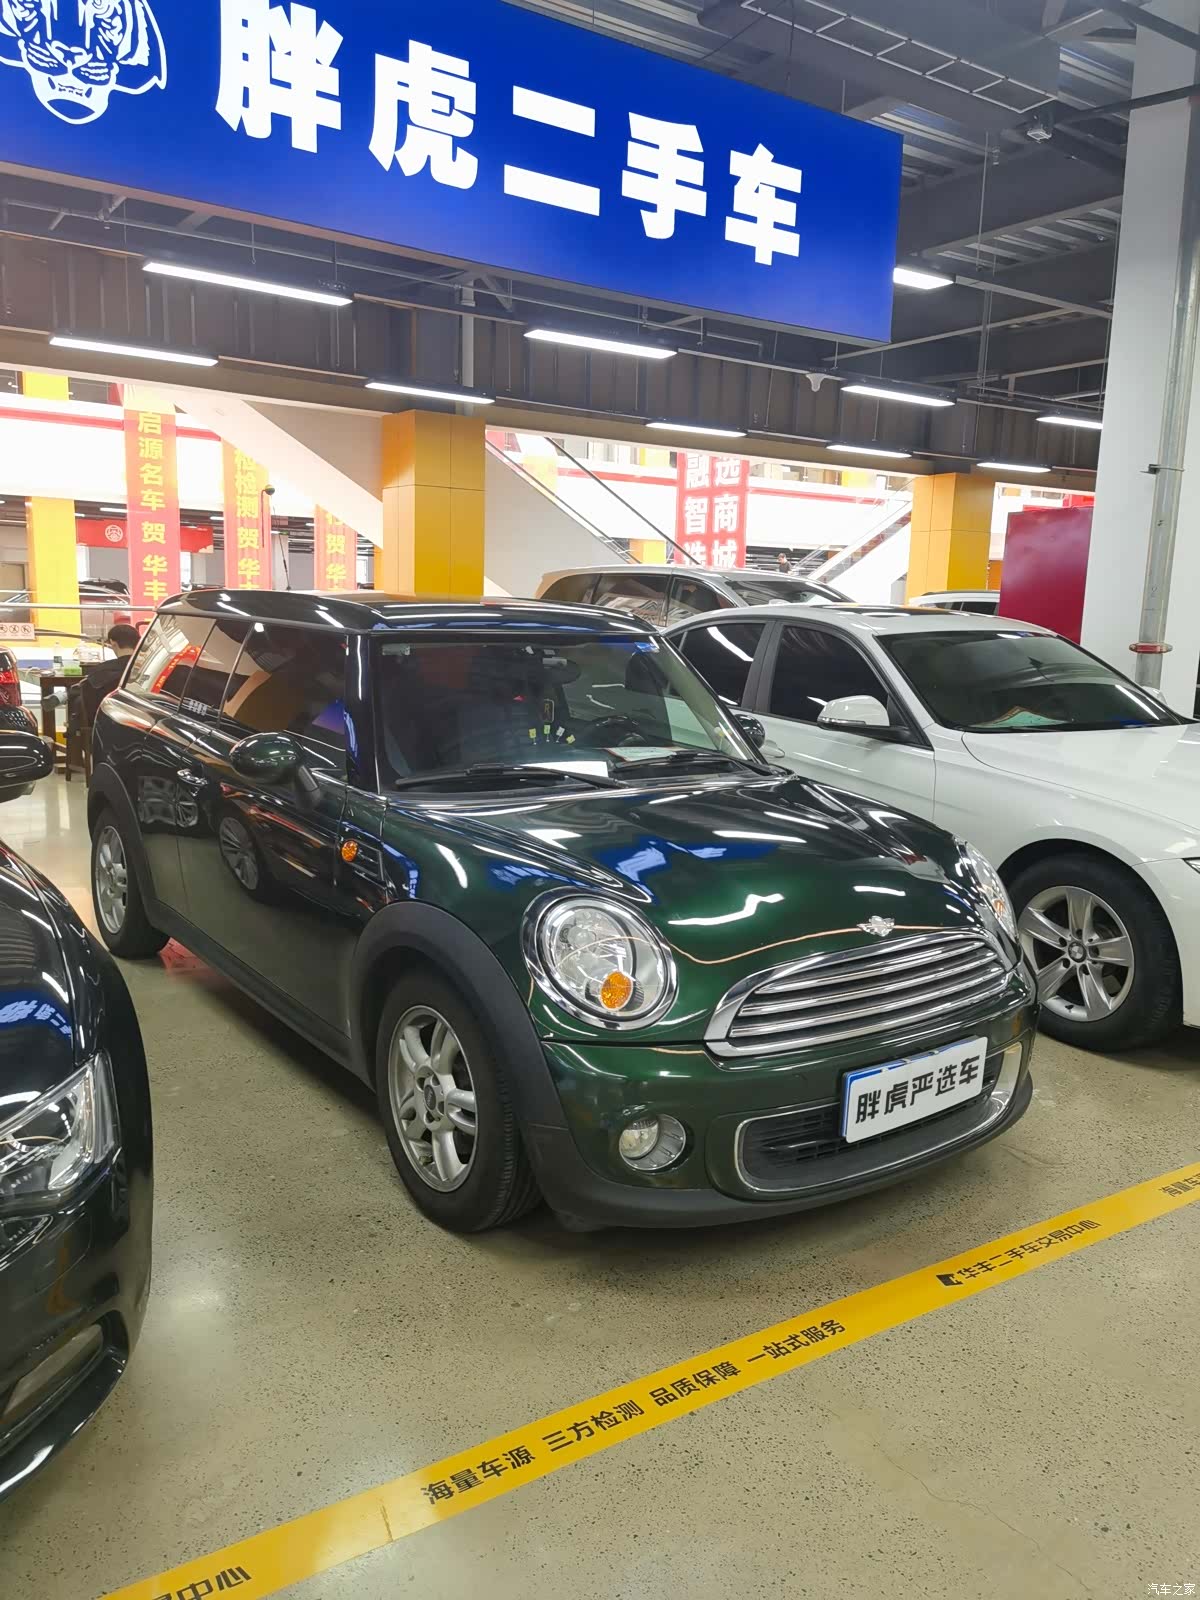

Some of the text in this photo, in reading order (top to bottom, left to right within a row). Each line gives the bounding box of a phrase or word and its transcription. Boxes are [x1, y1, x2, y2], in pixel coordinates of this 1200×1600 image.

[215, 0, 802, 266] 胖虎二手车
[855, 1055, 980, 1124] 胖虎严选车
[956, 1219, 1102, 1280] 华丰二手车交易中心
[420, 1319, 847, 1505] 海量车源 三方检测 品质保障 一站式服务
